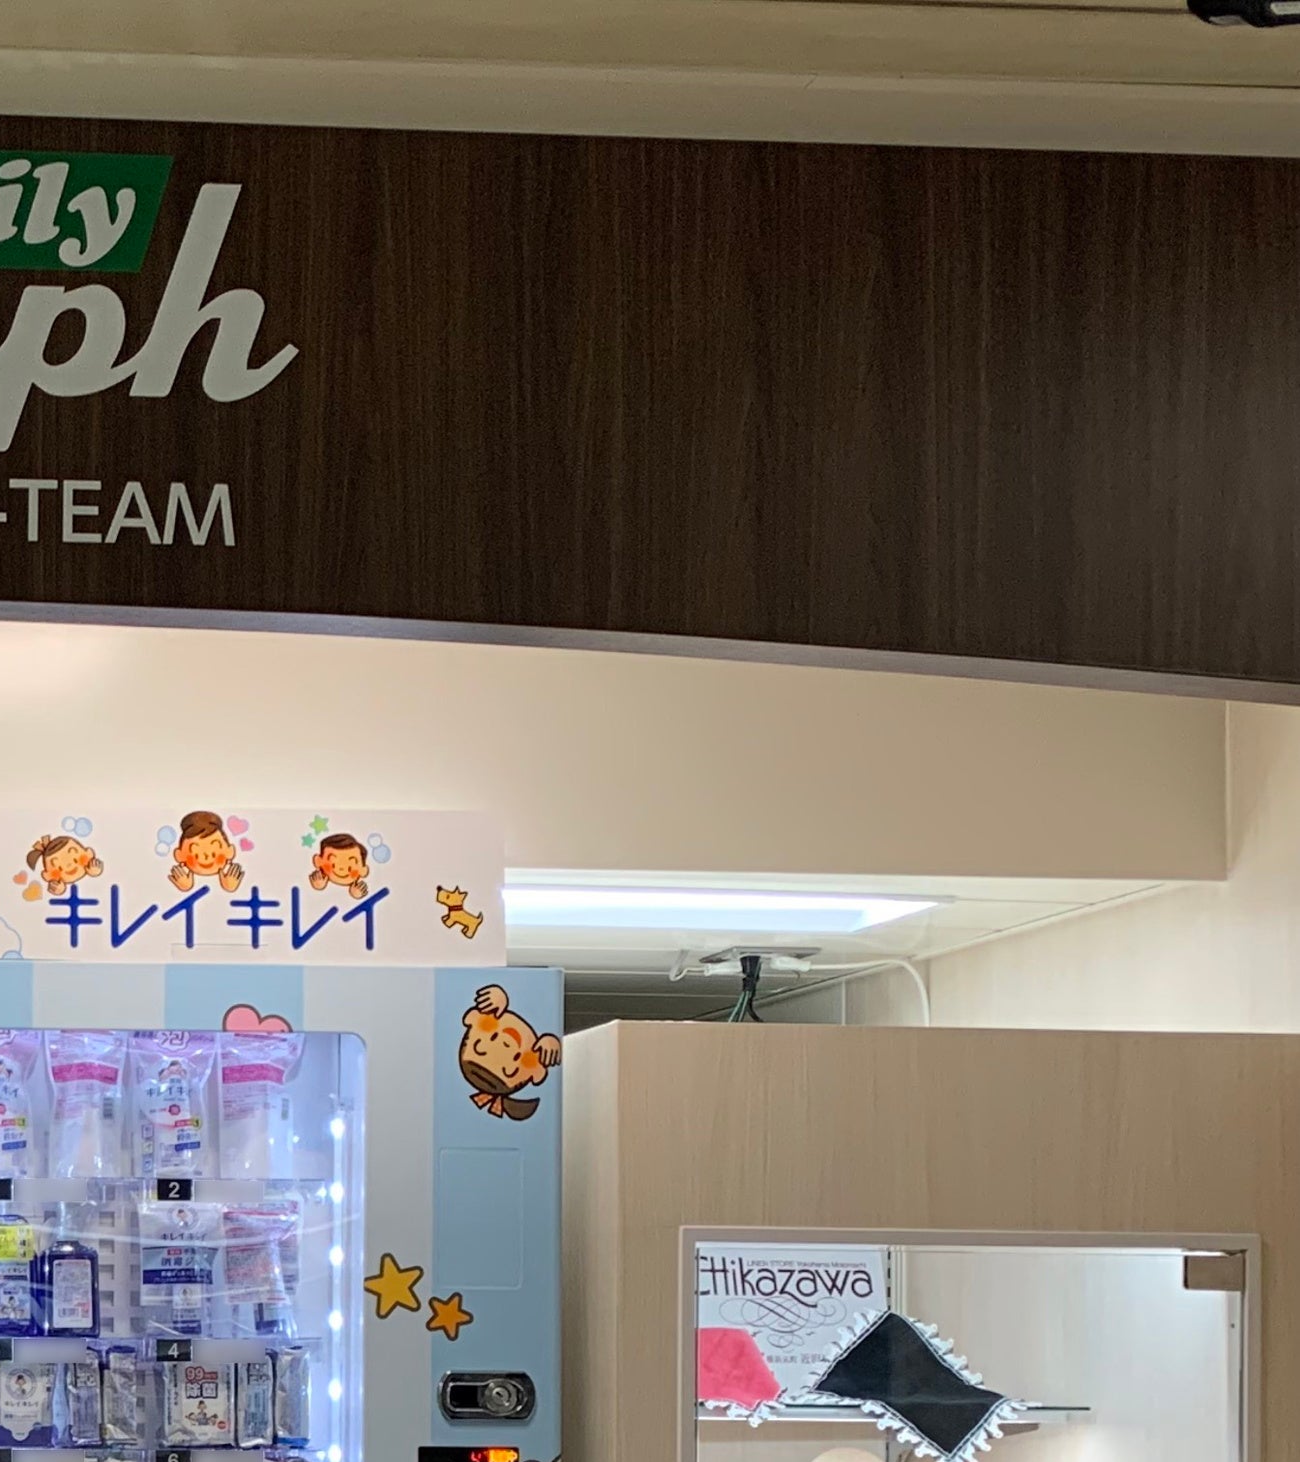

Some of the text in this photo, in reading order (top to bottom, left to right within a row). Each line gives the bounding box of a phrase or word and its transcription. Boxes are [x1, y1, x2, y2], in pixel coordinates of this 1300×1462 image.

[45, 884, 390, 950] キレイキレイ
[168, 1181, 181, 1197] 2
[167, 1343, 180, 1358] 4
